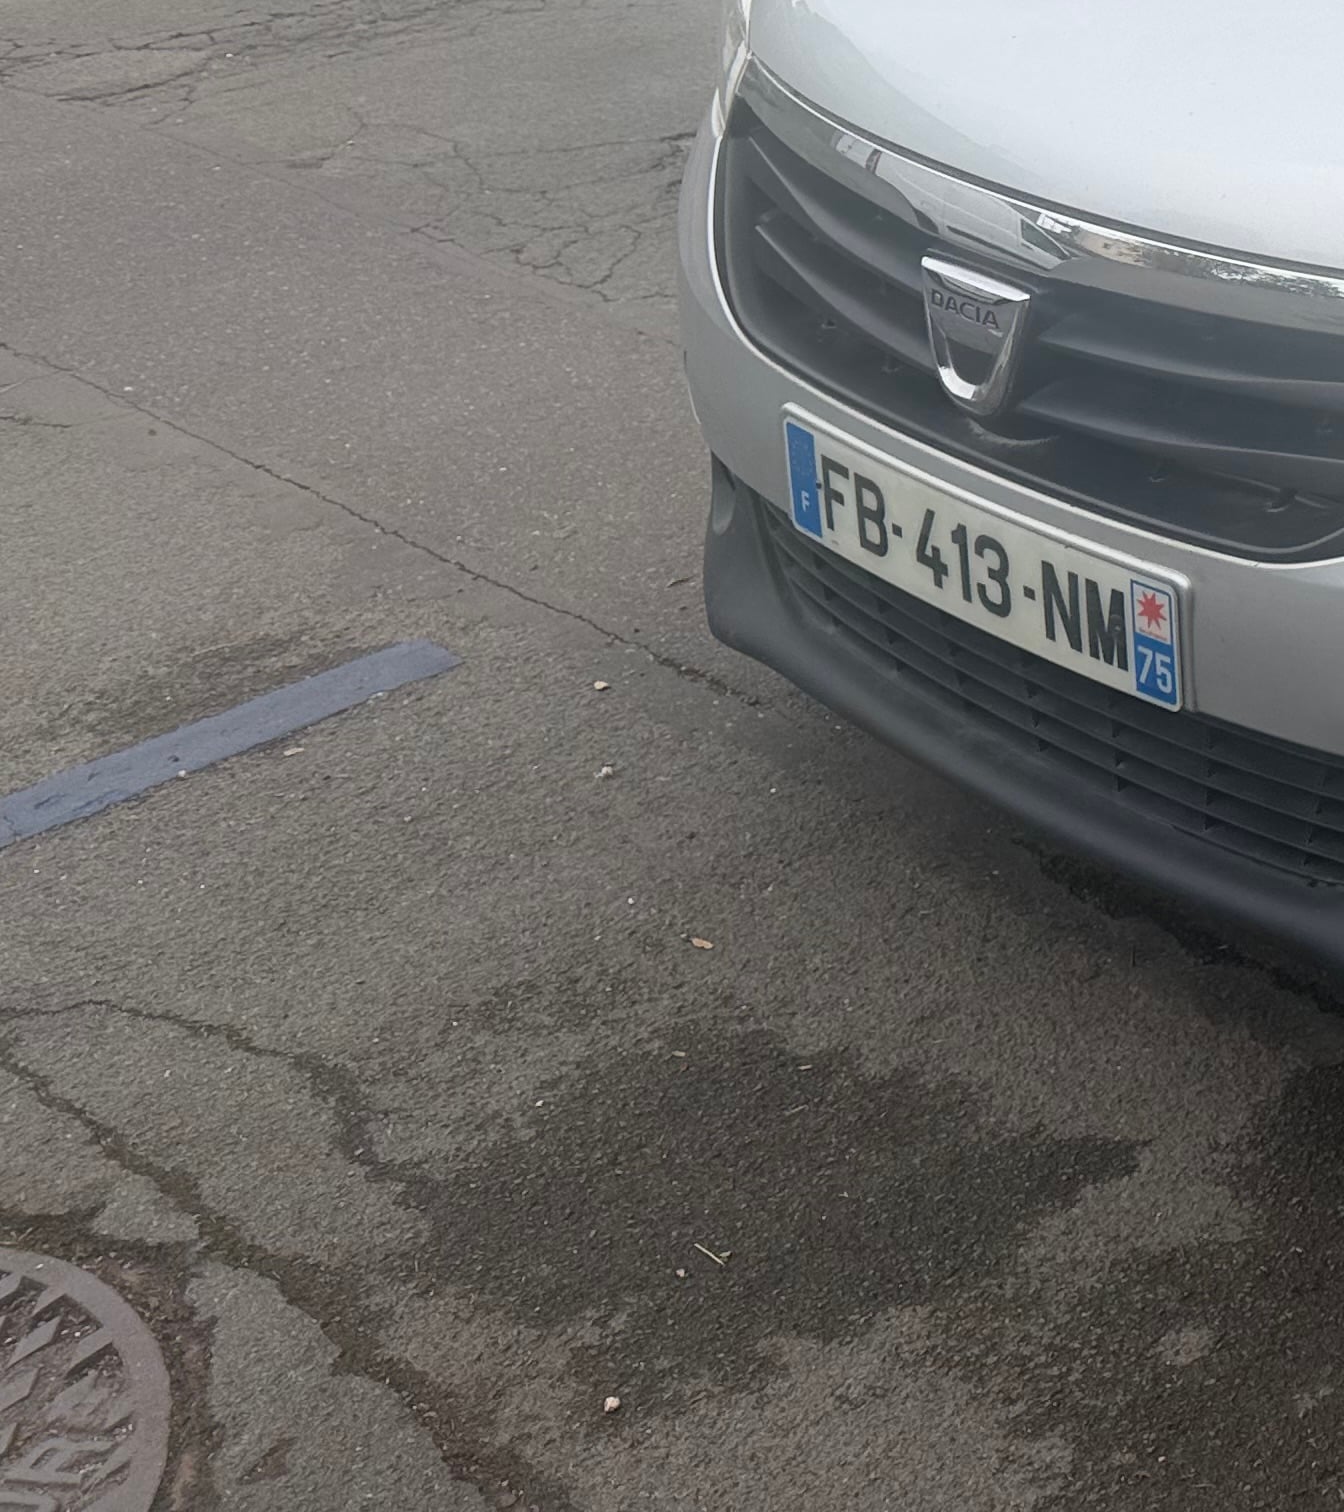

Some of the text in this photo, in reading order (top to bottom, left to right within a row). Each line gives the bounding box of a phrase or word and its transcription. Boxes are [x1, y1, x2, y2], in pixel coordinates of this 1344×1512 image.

[931, 289, 1000, 330] DACIA
[801, 490, 810, 512] F
[821, 454, 1130, 672] FB-413-NM
[1137, 645, 1173, 694] 75
